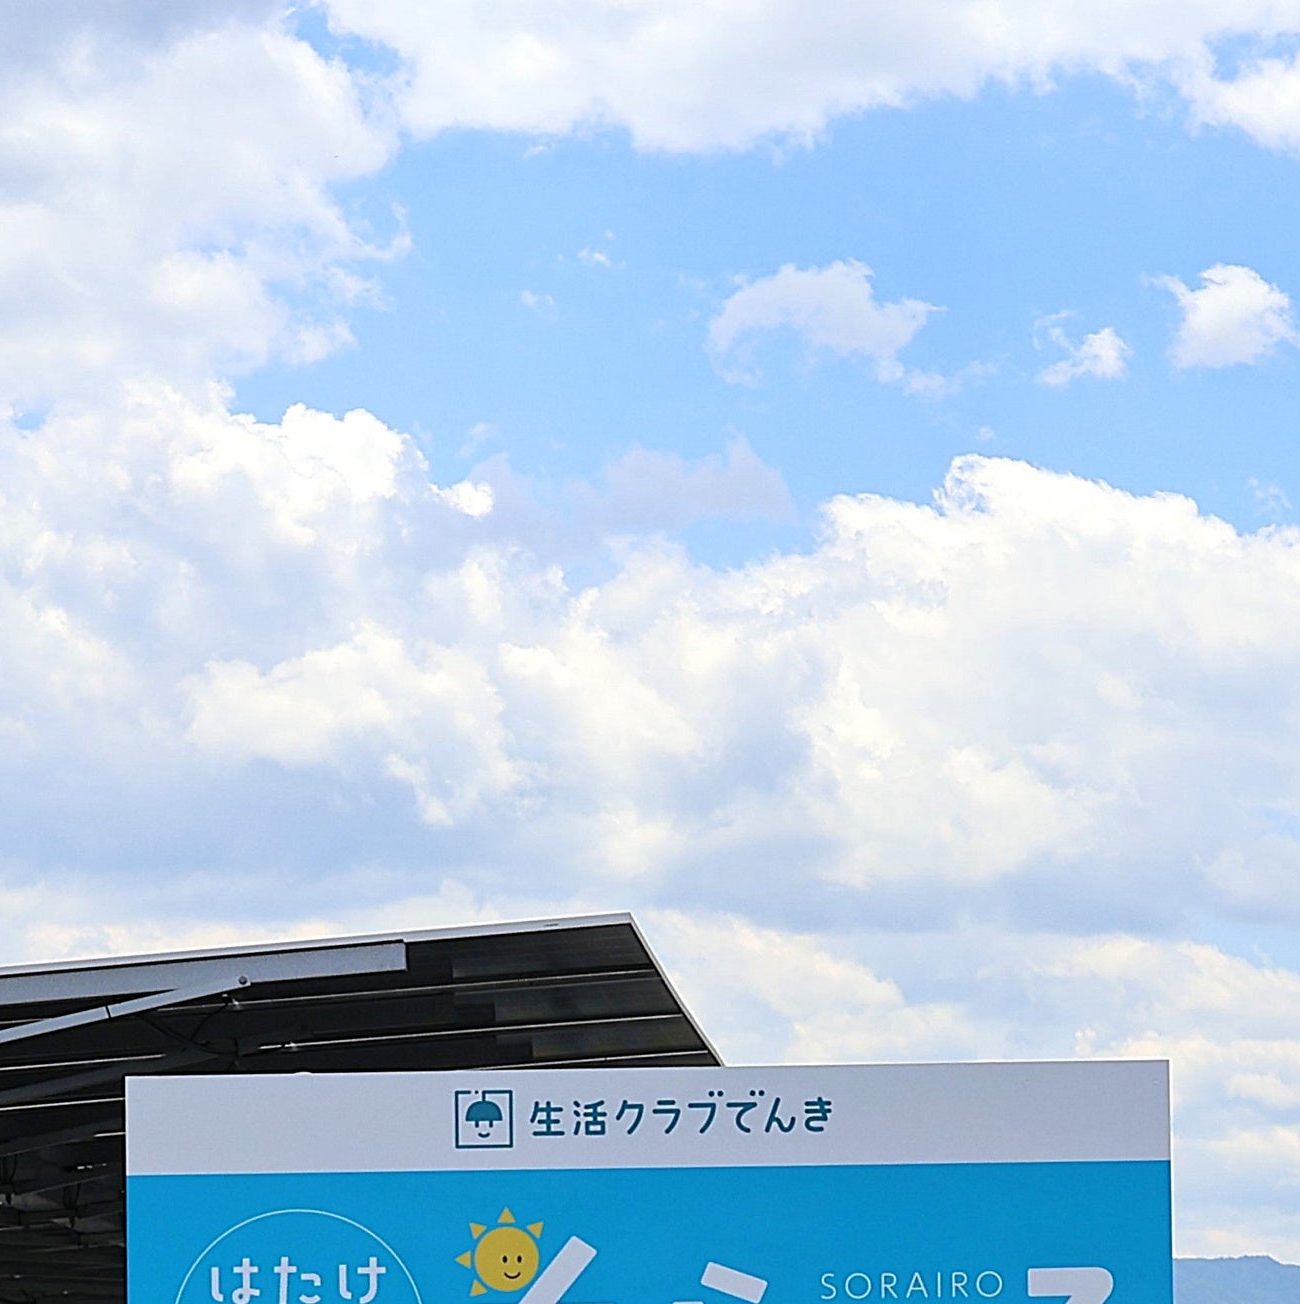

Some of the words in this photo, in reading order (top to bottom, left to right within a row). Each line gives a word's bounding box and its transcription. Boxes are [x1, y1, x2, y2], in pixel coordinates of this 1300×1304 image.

[529, 1089, 833, 1137] 生活クラブでんき
[819, 1270, 1004, 1300] SORAIRO
